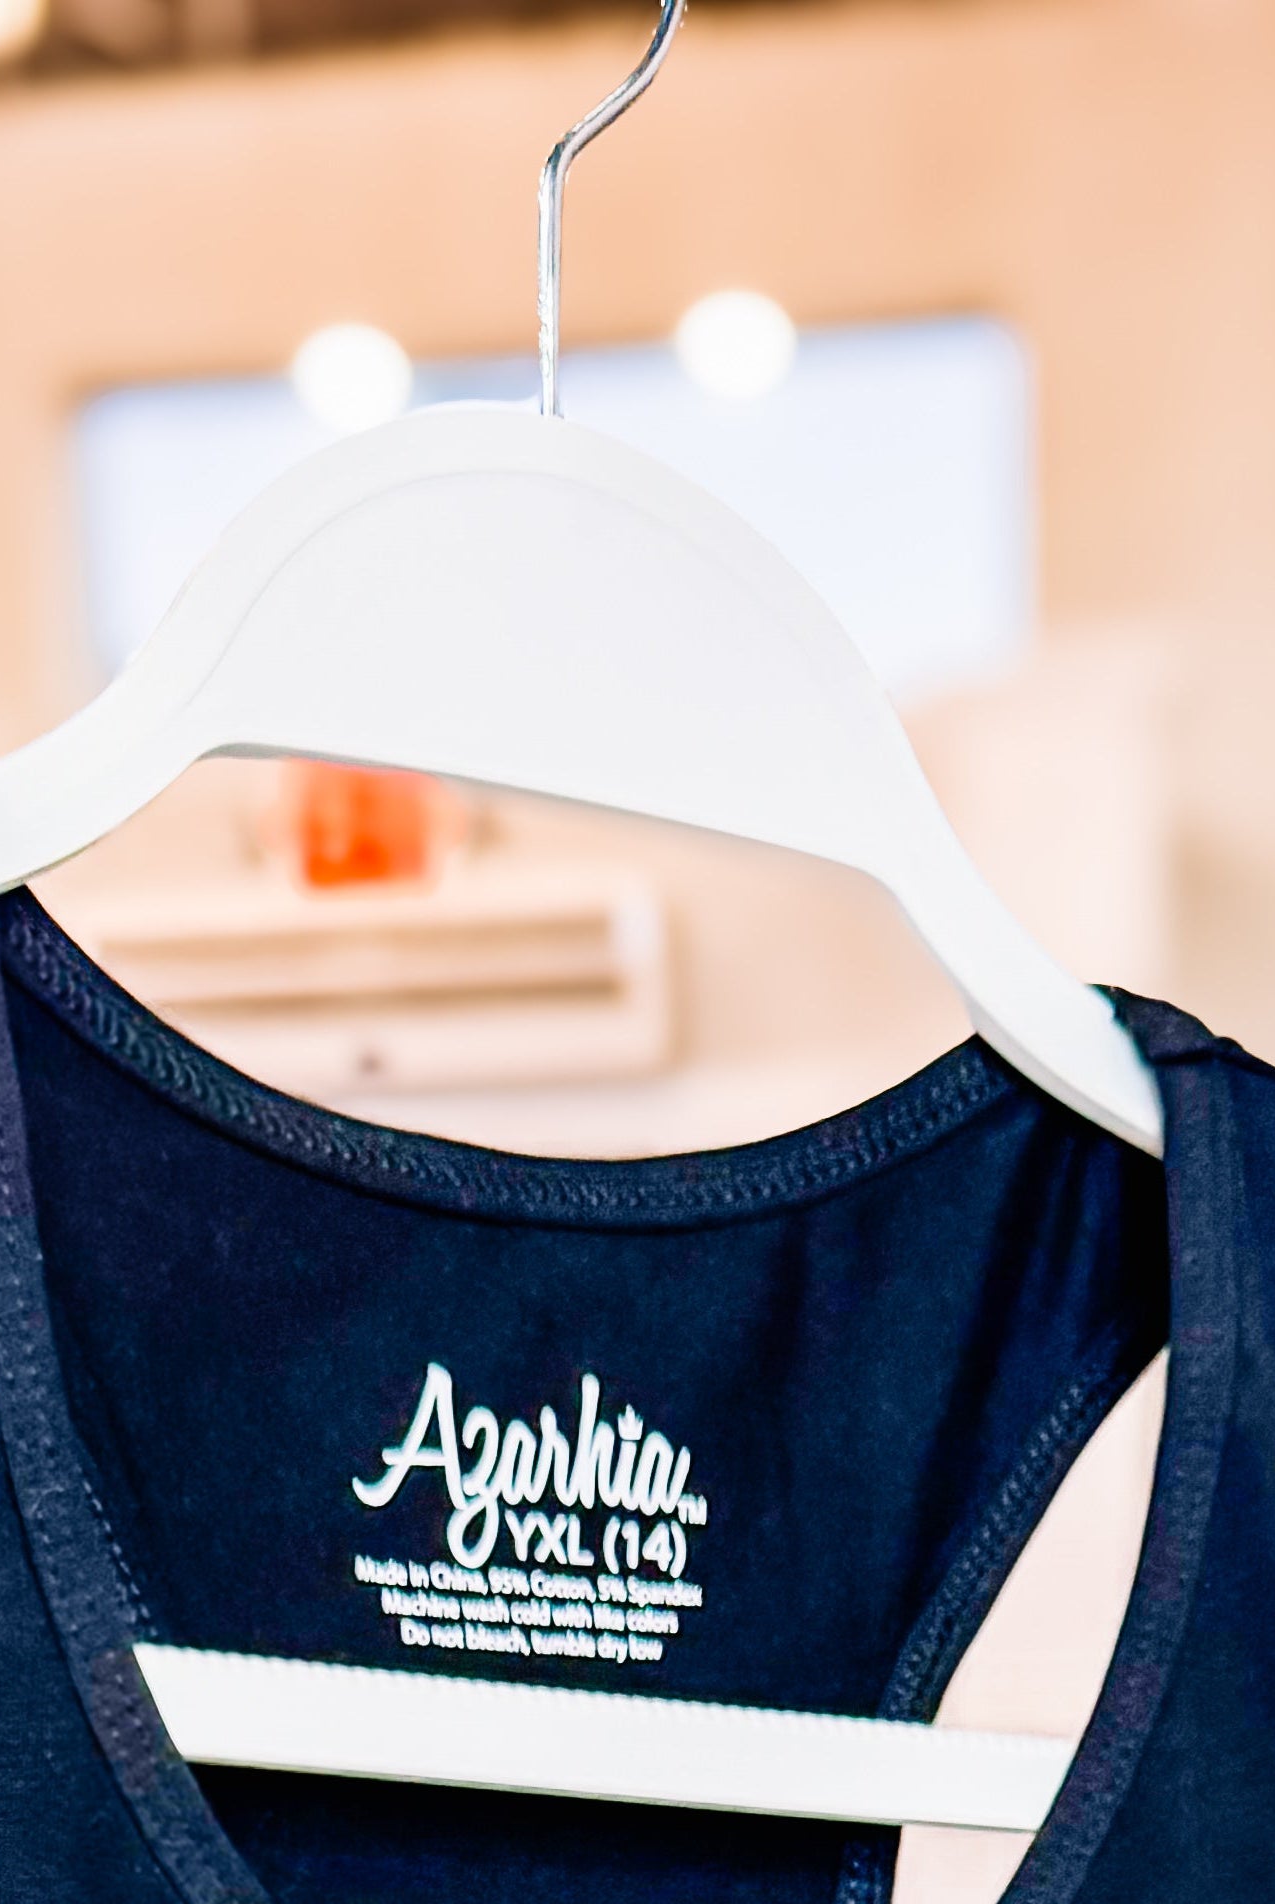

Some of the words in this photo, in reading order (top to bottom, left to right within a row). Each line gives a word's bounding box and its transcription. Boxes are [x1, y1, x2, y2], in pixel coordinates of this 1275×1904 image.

[352, 1362, 690, 1569] Azarhia
[504, 1509, 595, 1567] YXL
[603, 1515, 687, 1579] (14)
[354, 1554, 408, 1587] Made
[381, 1586, 461, 1620] Machine
[461, 1595, 510, 1623] wash
[510, 1598, 552, 1627] cold
[551, 1600, 593, 1629] with
[400, 1617, 432, 1646] Do
[430, 1622, 465, 1650] not
[596, 1631, 628, 1664] dry
[628, 1632, 664, 1661] low
